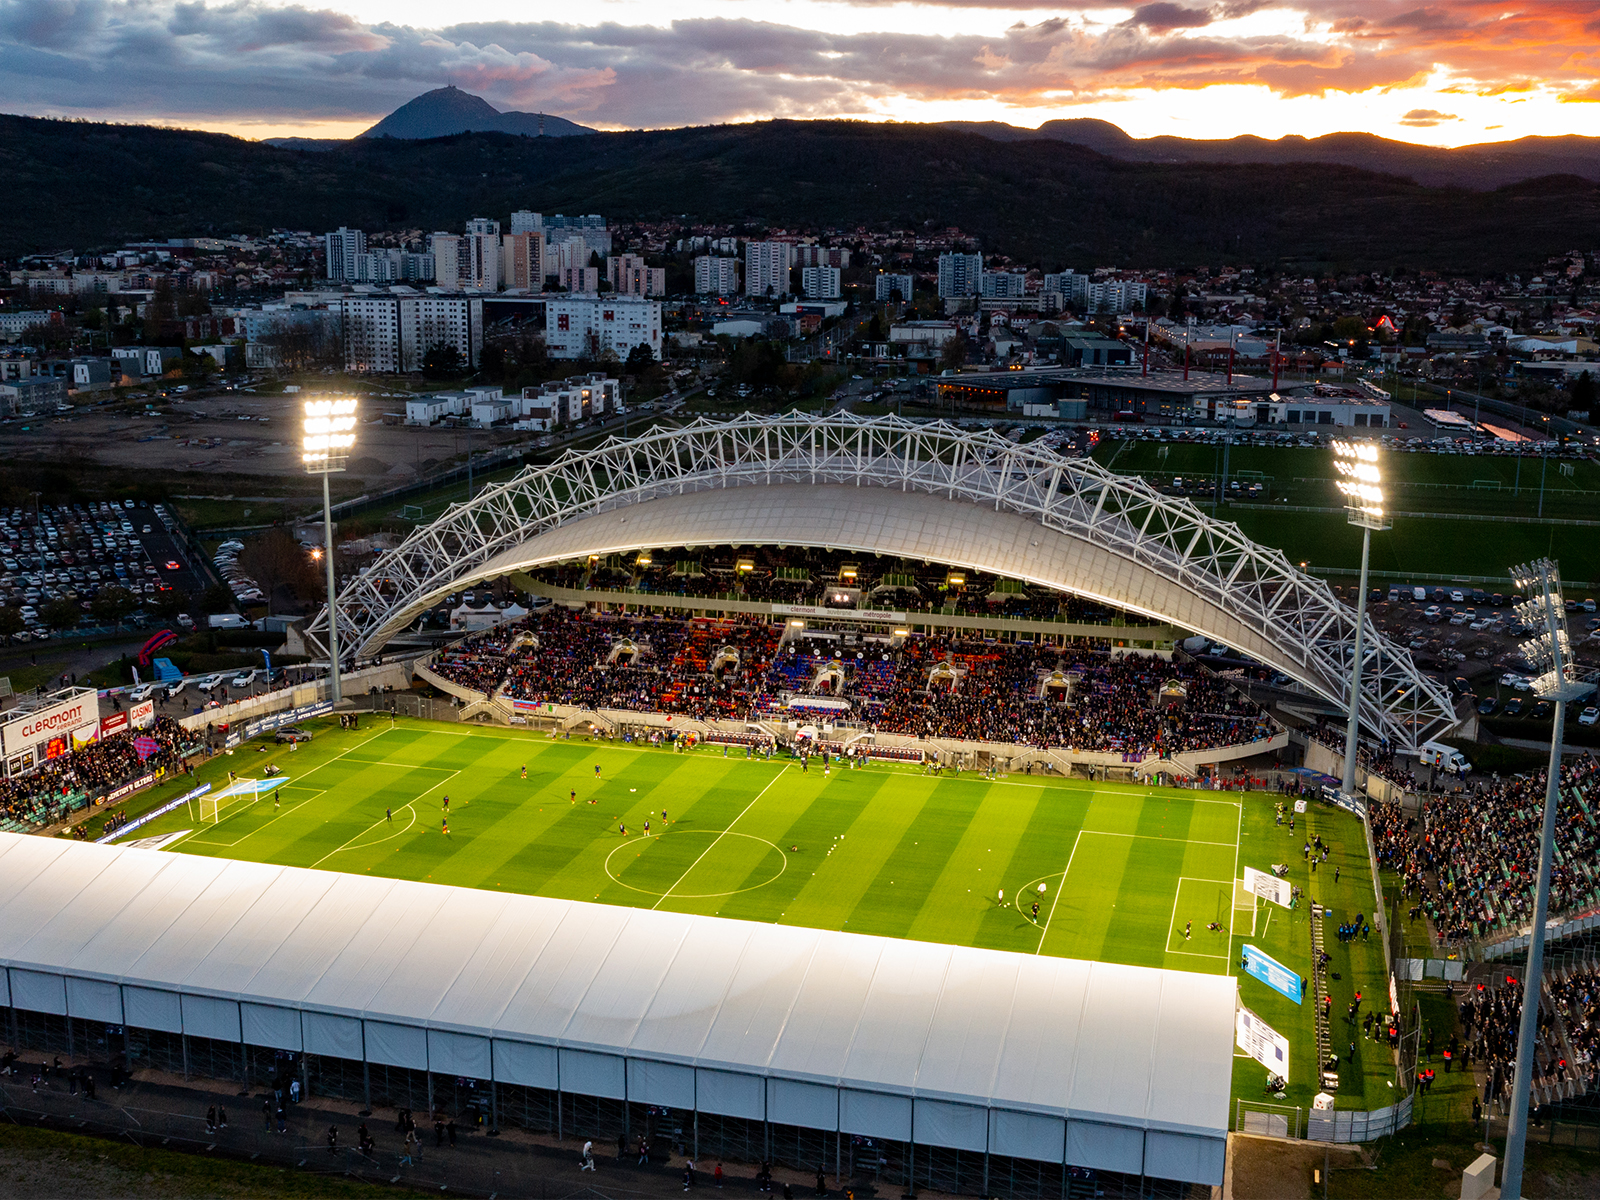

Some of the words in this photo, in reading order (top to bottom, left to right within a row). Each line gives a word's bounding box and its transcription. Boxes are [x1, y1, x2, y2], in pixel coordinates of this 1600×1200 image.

[790, 606, 816, 614] clermont
[862, 611, 892, 620] métropole
[132, 703, 152, 720] CASINO
